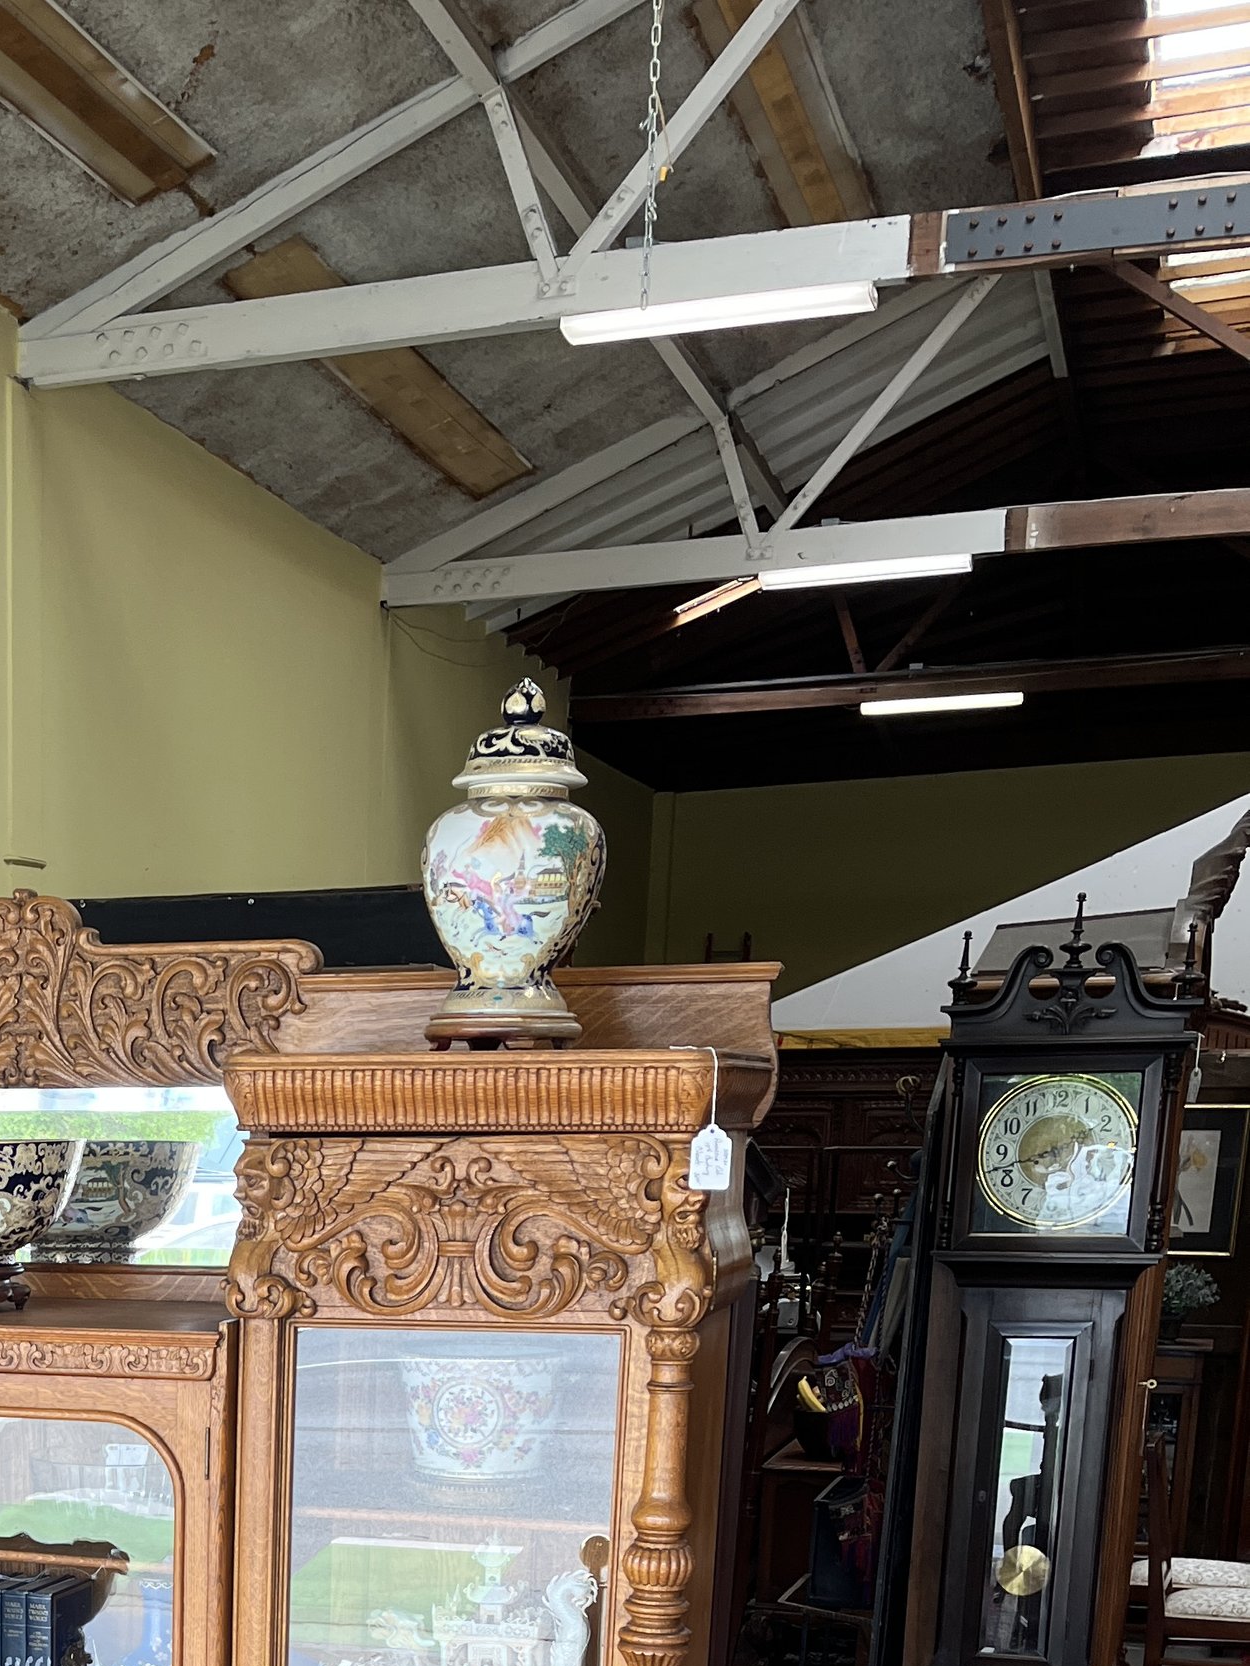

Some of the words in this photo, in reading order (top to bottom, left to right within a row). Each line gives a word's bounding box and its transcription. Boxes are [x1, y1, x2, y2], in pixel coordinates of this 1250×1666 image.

[1052, 1089, 1070, 1108] 12
[1084, 1097, 1090, 1114] 1
[1025, 1099, 1039, 1117] 11
[1003, 1117, 1021, 1135] 10
[1100, 1115, 1112, 1133] 2
[996, 1144, 1008, 1162] 9
[1000, 1169, 1014, 1188] 8
[1021, 1188, 1033, 1206] 7
